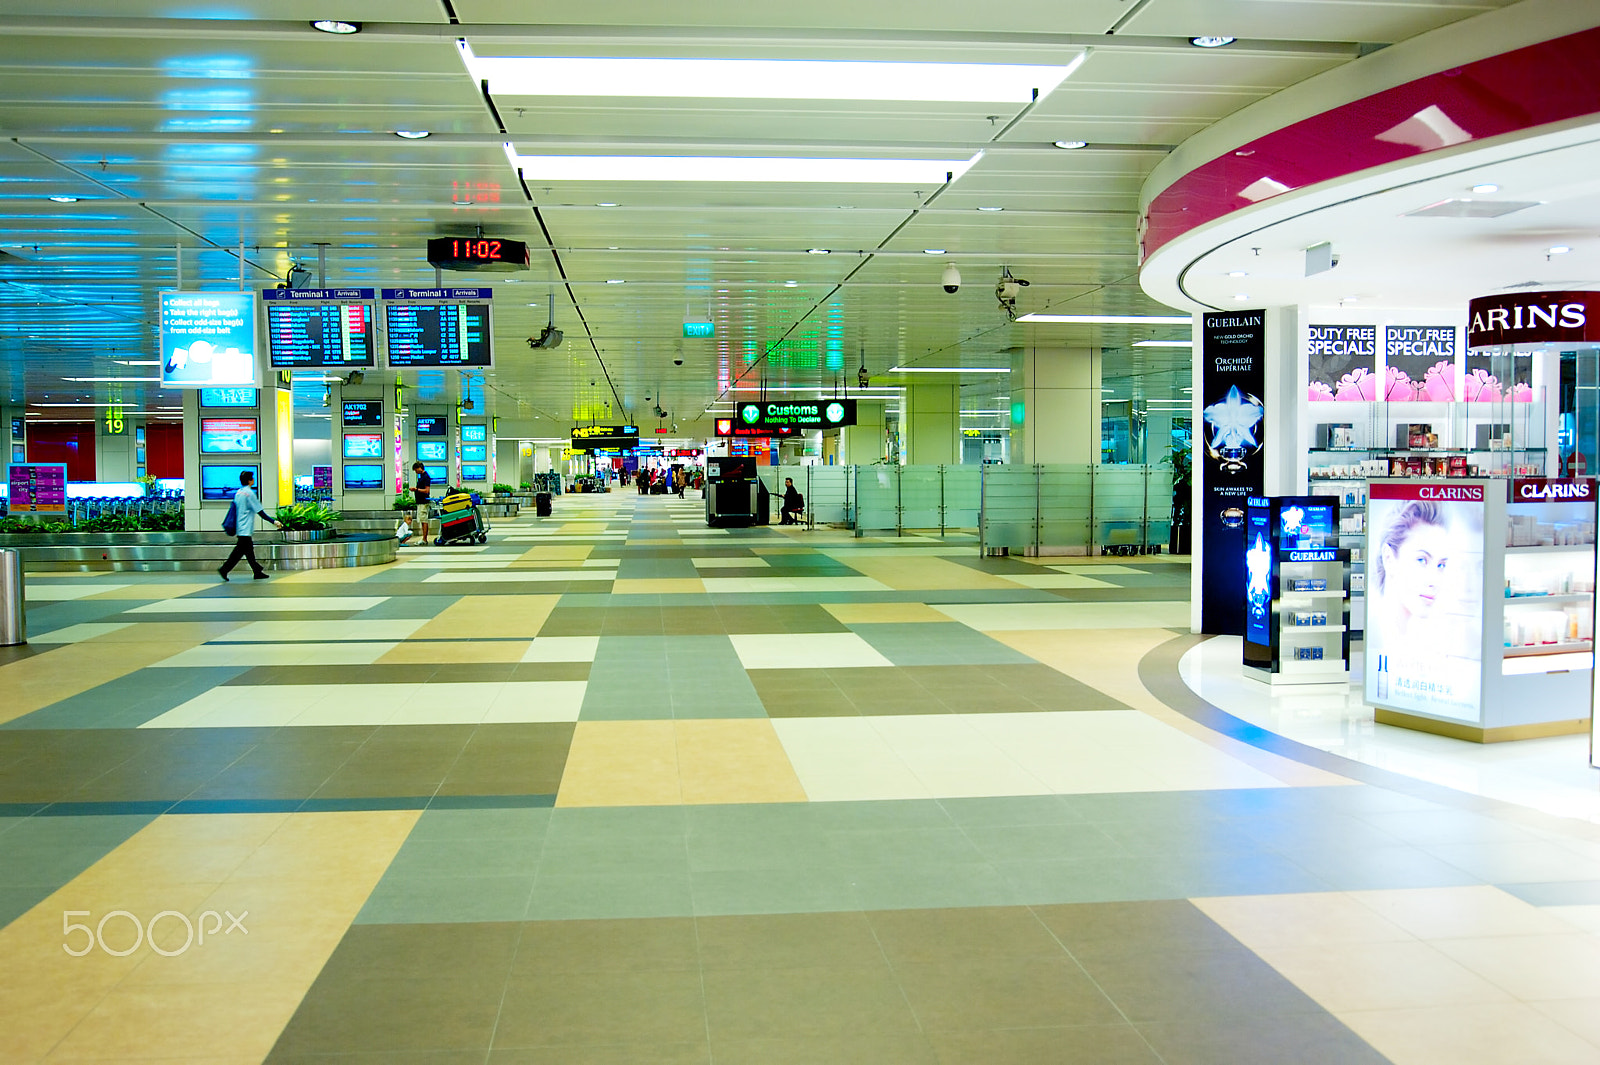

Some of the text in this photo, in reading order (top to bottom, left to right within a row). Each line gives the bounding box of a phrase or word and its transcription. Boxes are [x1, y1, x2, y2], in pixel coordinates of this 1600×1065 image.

[452, 240, 502, 258] 11:02
[290, 290, 329, 298] Terminal 1
[204, 299, 220, 307] bags
[200, 309, 216, 317] right
[218, 309, 238, 317] bag(s)
[1469, 304, 1586, 334] ARINS
[223, 318, 244, 327] bag(s)
[1207, 316, 1261, 328] GUERLAIN
[688, 326, 704, 335] EXIT
[1308, 328, 1374, 340] DUTY FREE
[1388, 328, 1454, 341] DUTY FREE
[1308, 340, 1374, 355] SPECIALS
[1387, 342, 1454, 356] SPECIALS
[1215, 356, 1253, 365] ORCHIDÉE
[767, 404, 818, 416] Customs
[105, 420, 124, 434] 19
[522, 448, 532, 457] 19
[1419, 487, 1482, 499] CLARINS
[1521, 484, 1590, 498] CLARINS
[1247, 497, 1270, 507] GUERLAIN
[1290, 551, 1335, 561] GUERLAIN
